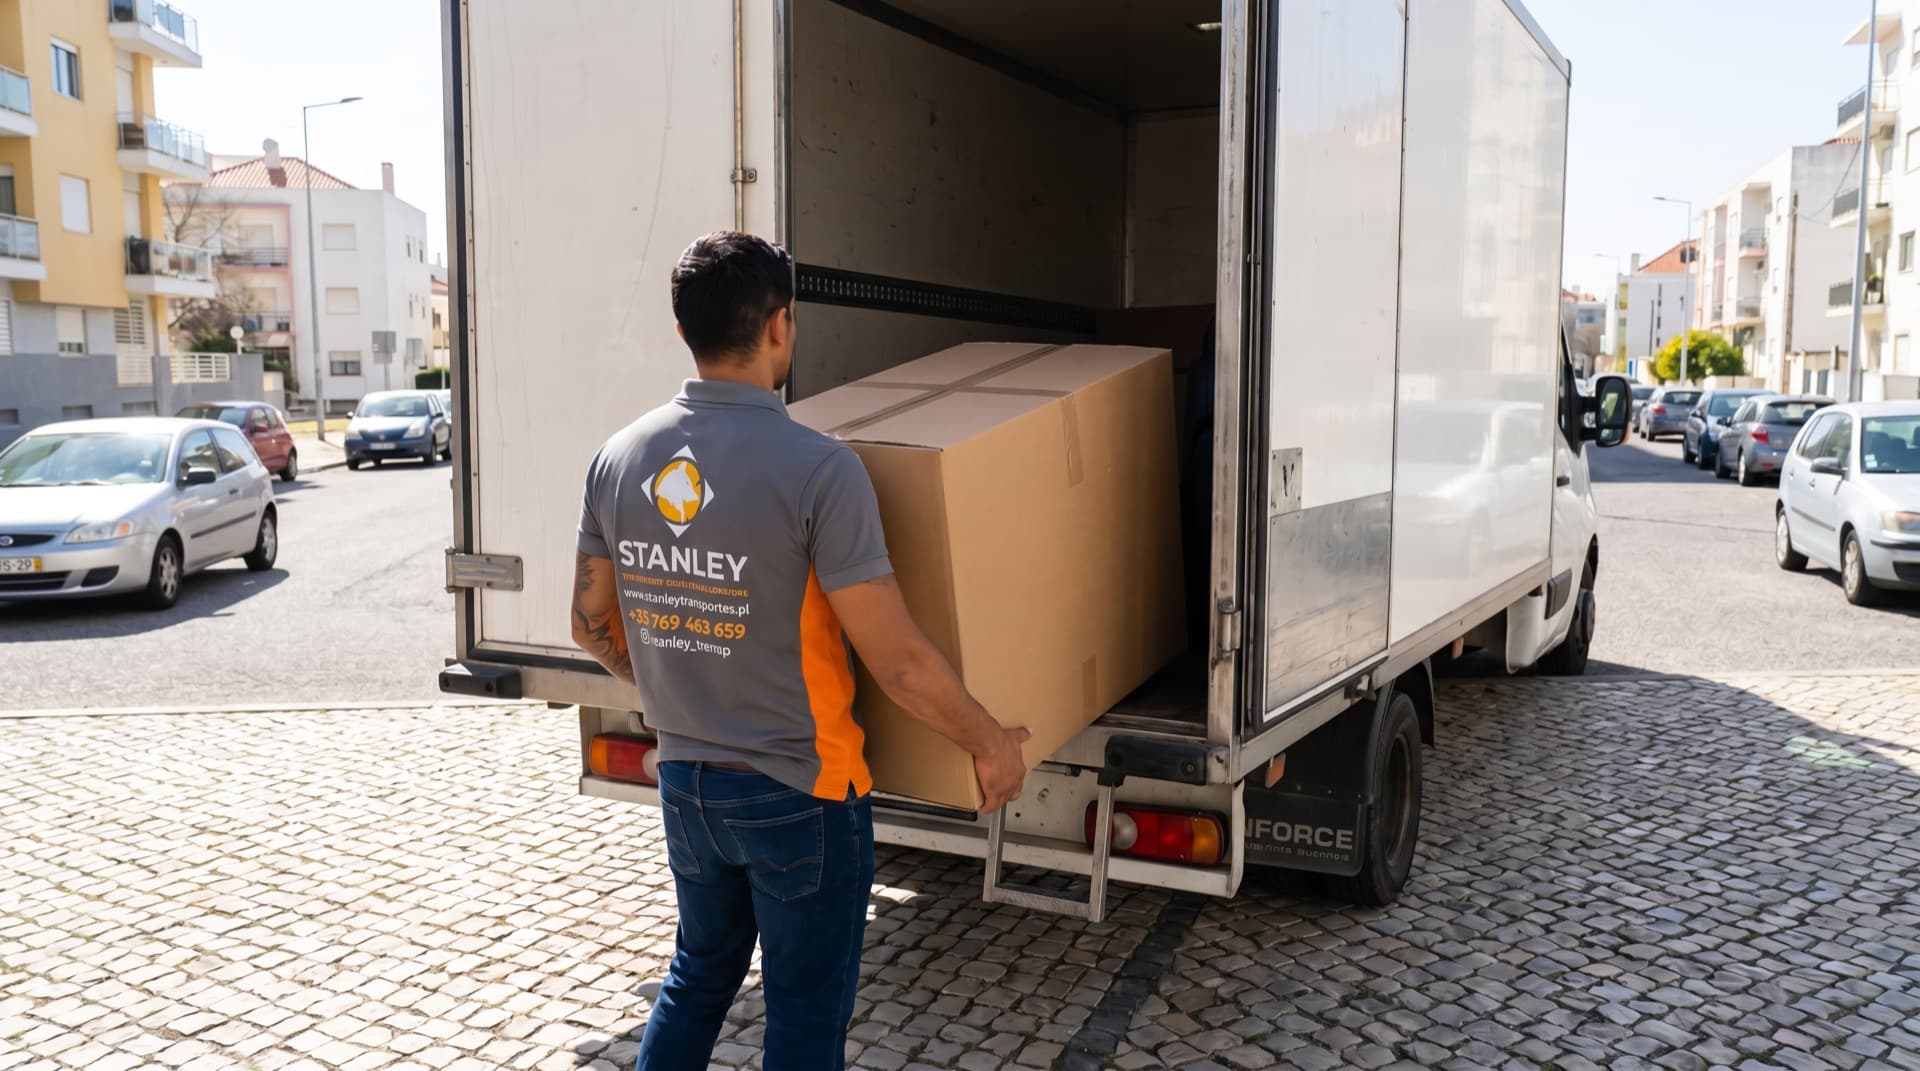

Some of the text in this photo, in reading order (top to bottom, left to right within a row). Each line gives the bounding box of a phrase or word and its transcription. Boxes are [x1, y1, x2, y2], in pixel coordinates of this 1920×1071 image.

[618, 539, 748, 582] STANLEY
[623, 588, 750, 617] www.stanleytransportes.pl
[628, 608, 746, 640] +35 769 463 659
